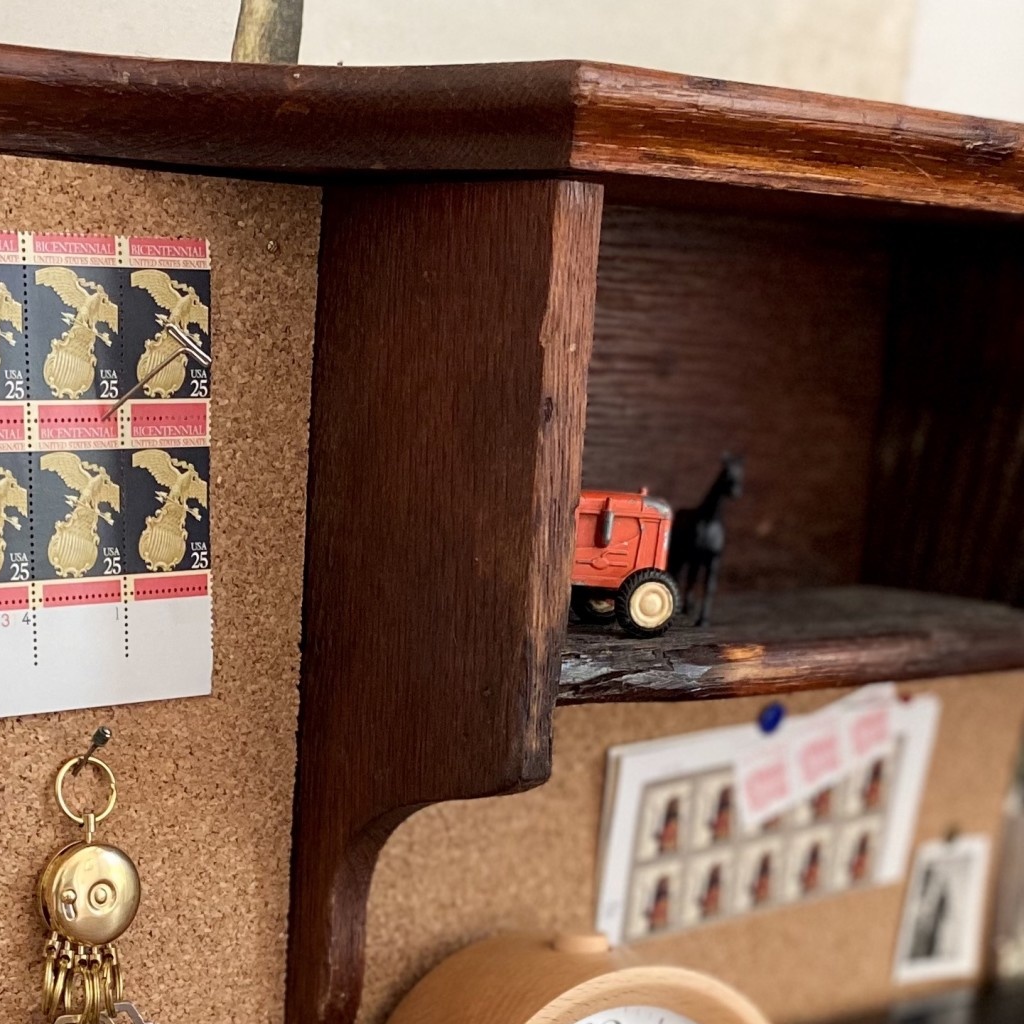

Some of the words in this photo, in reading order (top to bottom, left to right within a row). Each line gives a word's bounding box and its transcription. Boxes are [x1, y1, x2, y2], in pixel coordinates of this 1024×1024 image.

[36, 240, 113, 254] BICENTENNIAL
[131, 244, 205, 257] BICENTENNIAL
[33, 255, 61, 263] UNITED
[64, 256, 88, 264] STATES
[89, 257, 115, 265] SENATE
[129, 258, 156, 266] UNITED
[158, 259, 180, 267] STATES
[182, 260, 207, 268] SENATE
[5, 370, 23, 380] USA
[100, 369, 117, 379] USA
[190, 369, 206, 379] USA
[5, 380, 24, 399] 25
[100, 379, 118, 398] 25
[190, 379, 208, 397] 25
[40, 427, 116, 439] BICENTENNIAL
[133, 425, 205, 436] BICENTENNIAL
[93, 440, 118, 448] SENATE
[132, 439, 157, 447] UNITED
[159, 438, 181, 446] STATES
[103, 547, 121, 557] USA
[191, 542, 206, 551] USA
[10, 552, 28, 562] USA
[191, 551, 208, 569] 25
[103, 557, 121, 575] 25
[10, 563, 30, 581] 25
[1, 613, 11, 627] 3
[22, 611, 31, 625] 4
